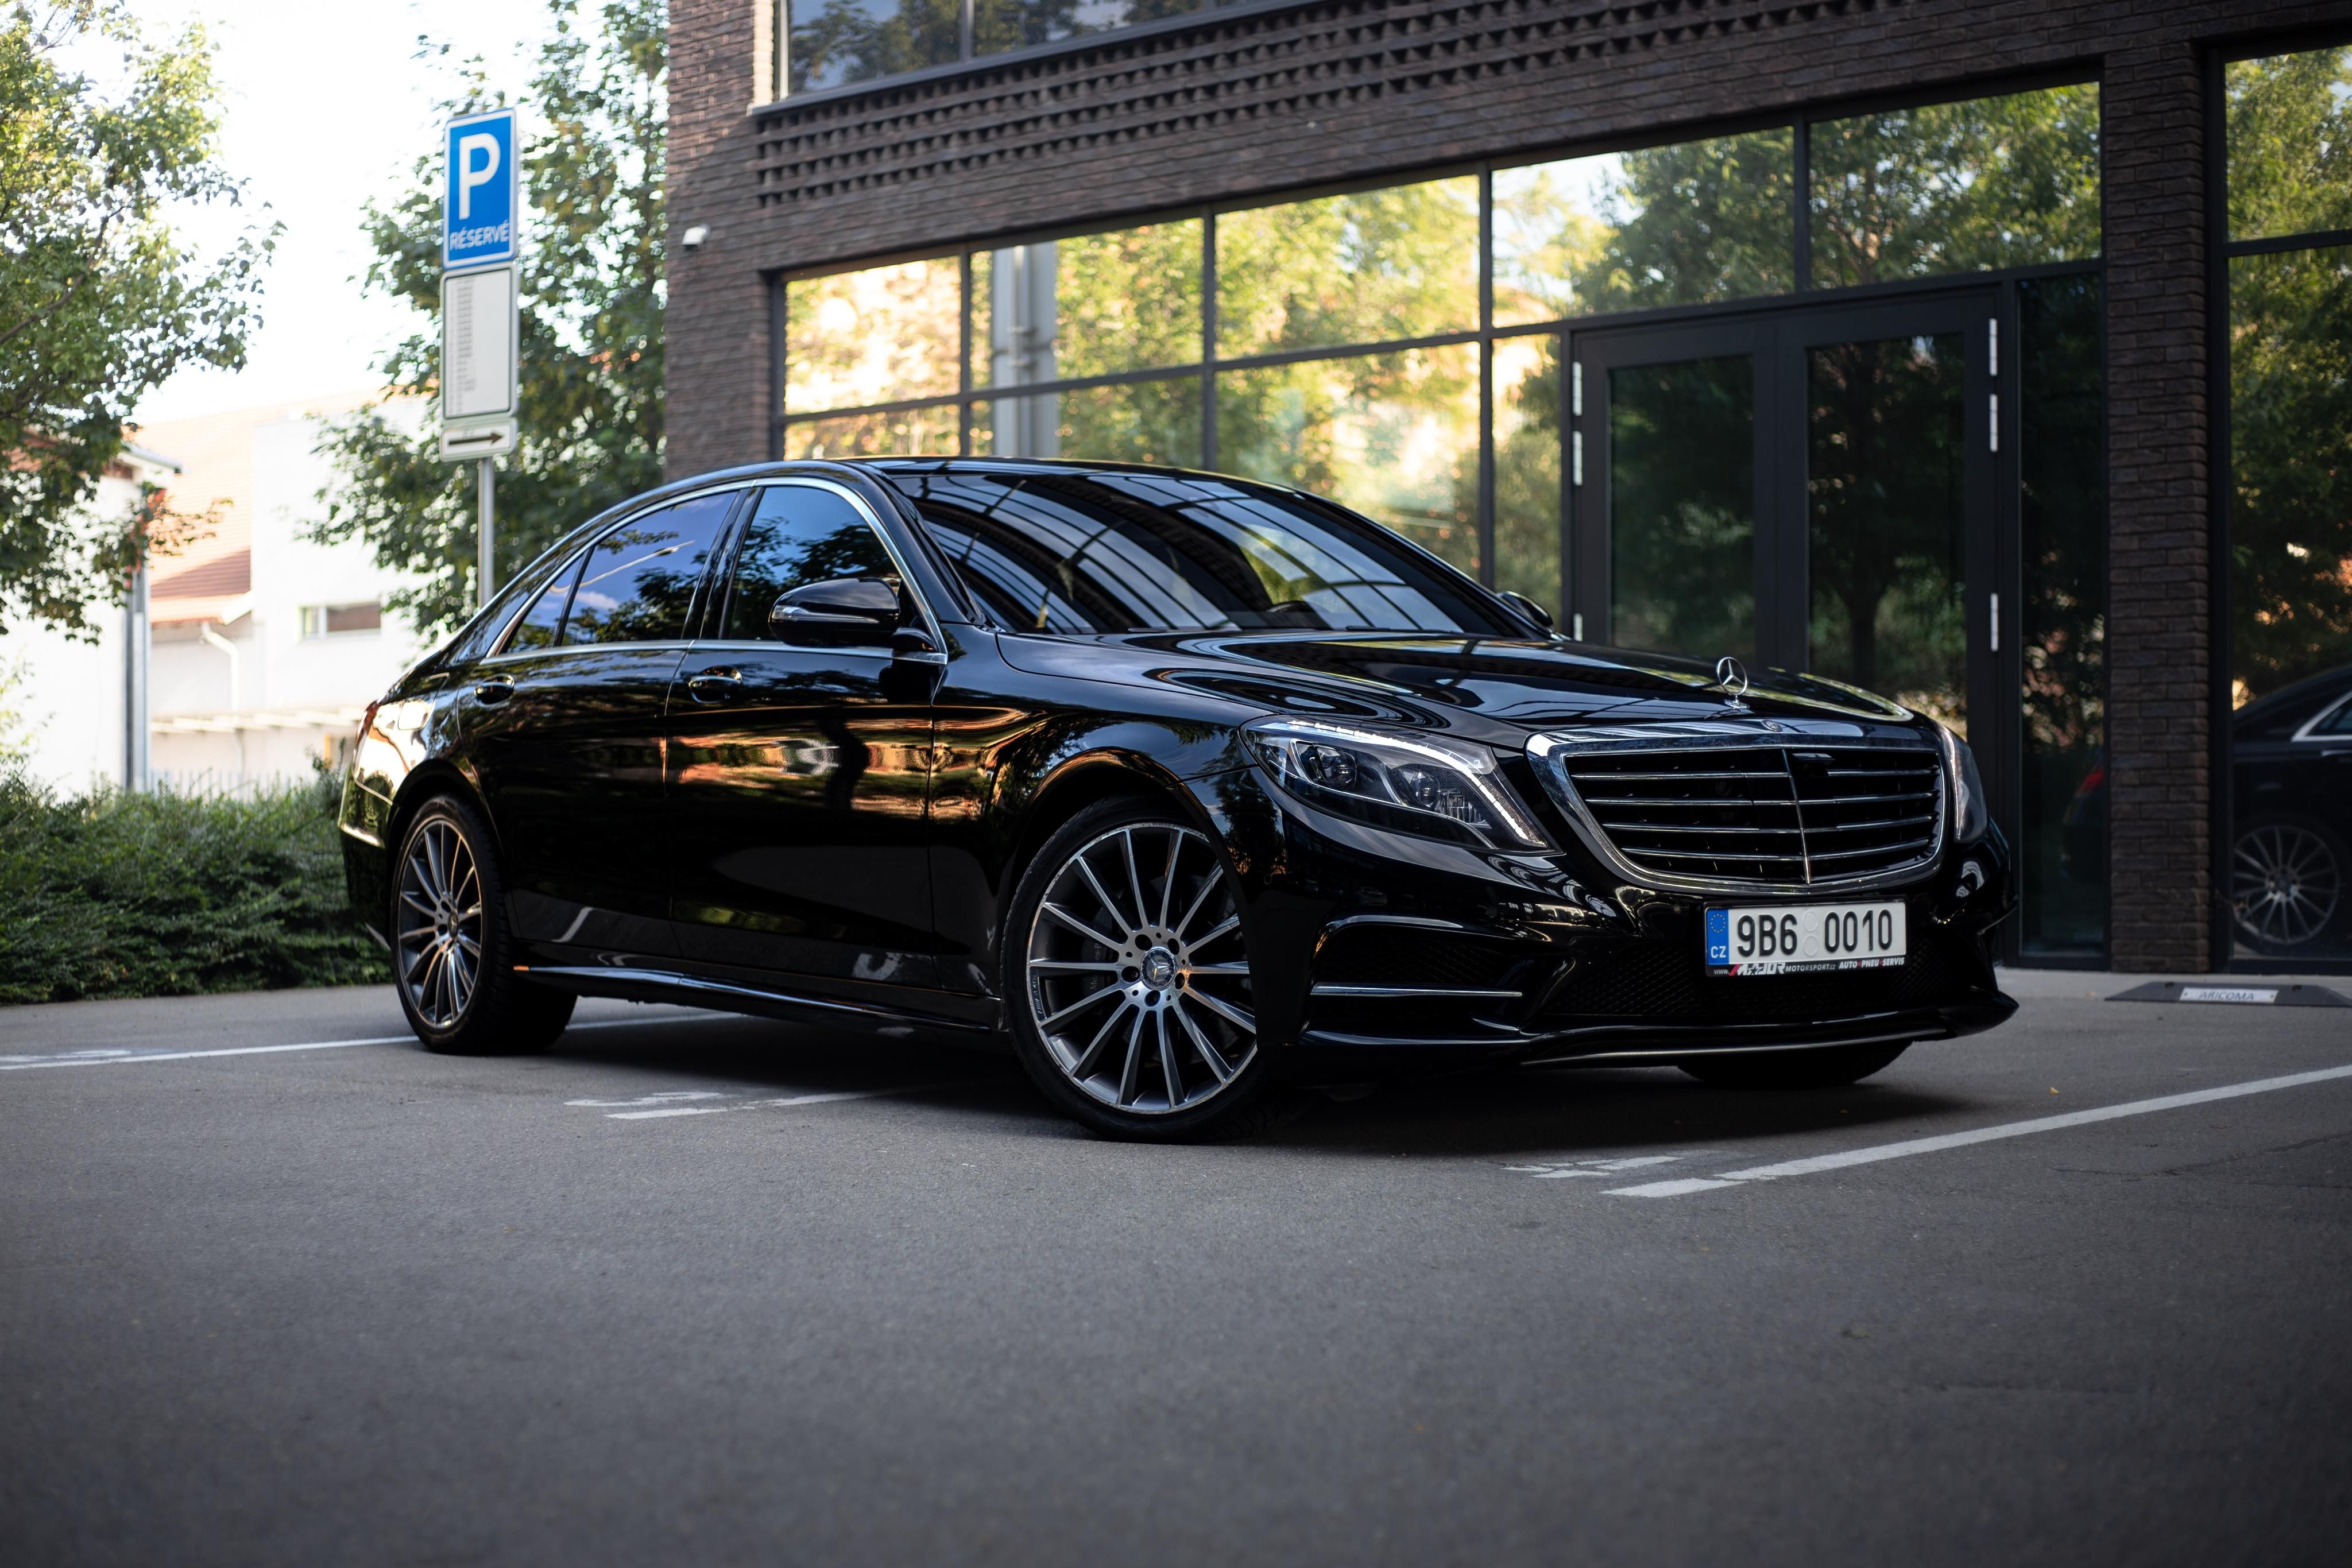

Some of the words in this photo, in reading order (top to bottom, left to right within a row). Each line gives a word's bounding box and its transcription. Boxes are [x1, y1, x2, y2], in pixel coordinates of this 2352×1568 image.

[459, 132, 501, 220] P
[450, 219, 510, 251] RÉSERVÉ
[1736, 913, 1798, 958] 9B6
[1824, 909, 1893, 953] 0010
[1710, 946, 1727, 959] CZ
[2199, 992, 2255, 1001] ARICOMA
